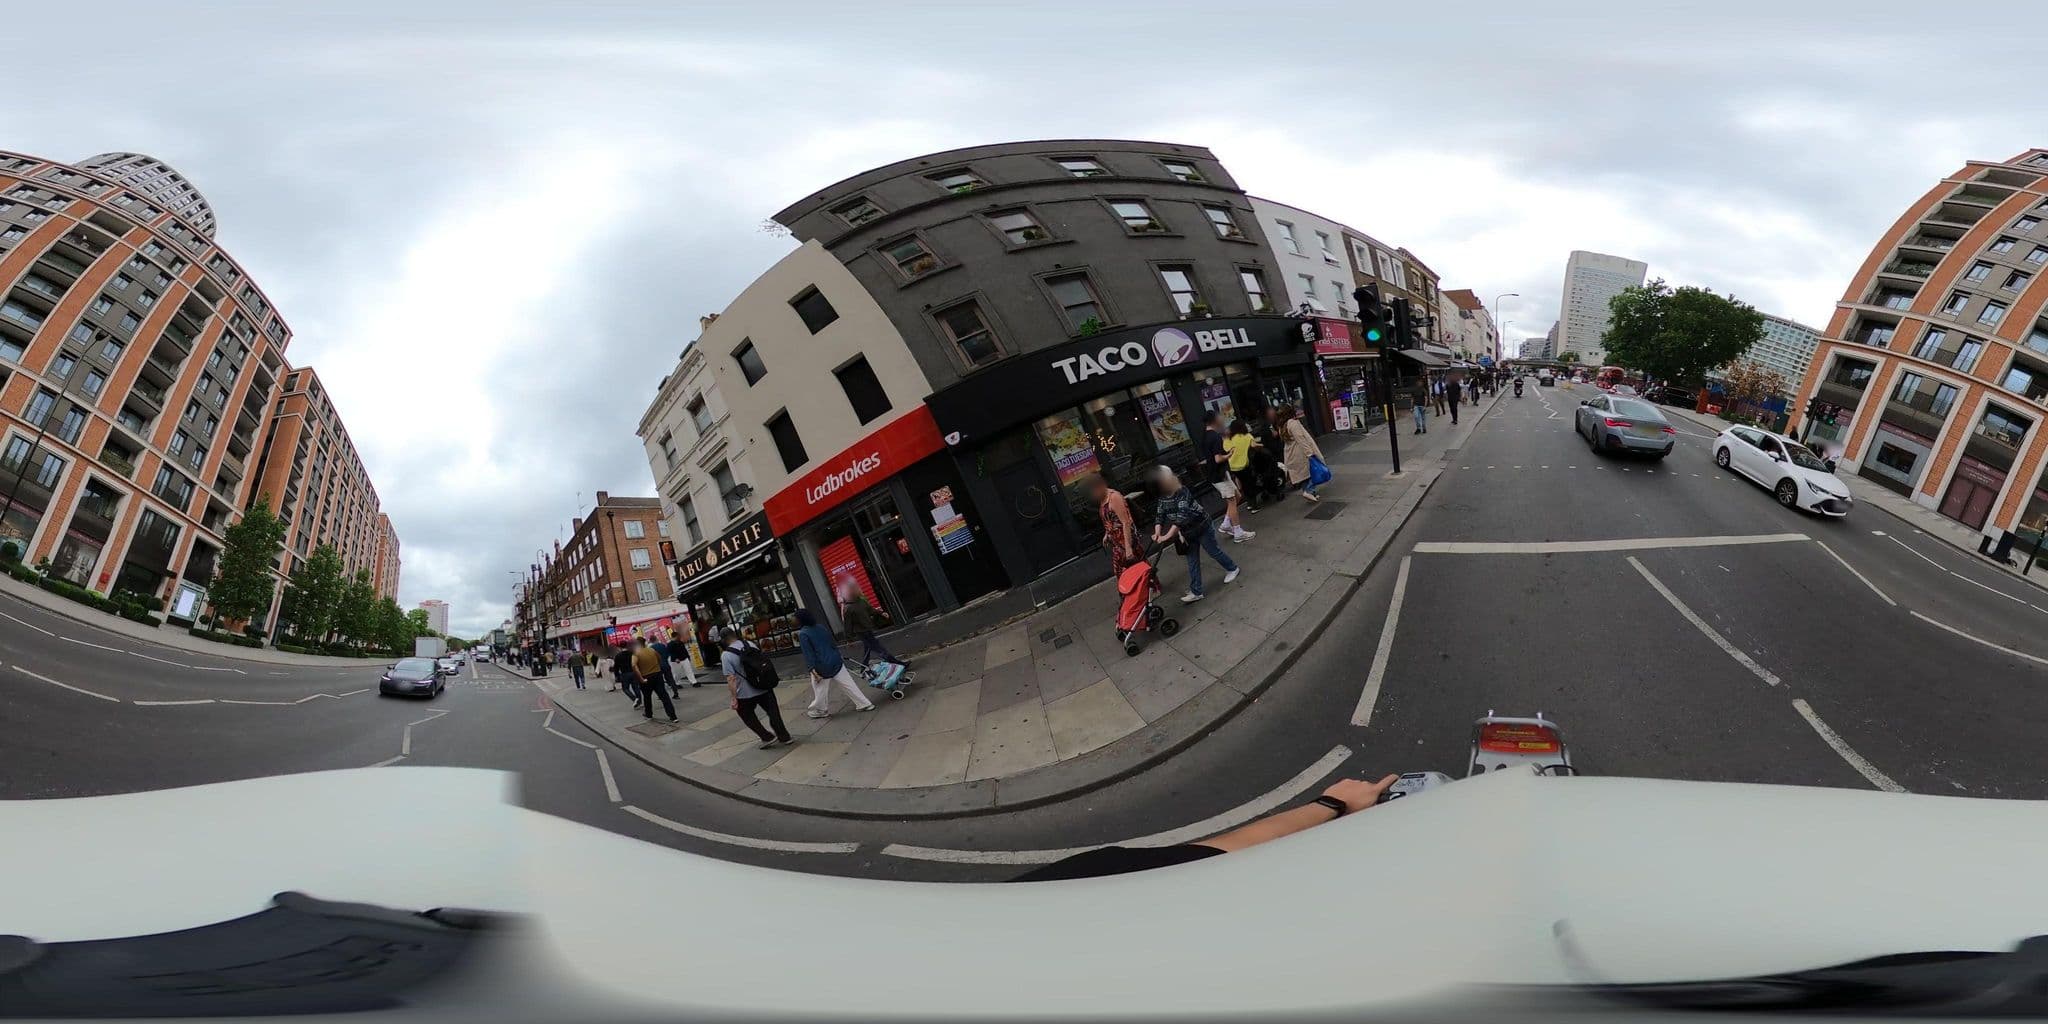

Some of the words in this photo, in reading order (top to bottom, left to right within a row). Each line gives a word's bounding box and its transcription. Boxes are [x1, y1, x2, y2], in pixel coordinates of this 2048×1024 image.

[1052, 342, 1147, 384] TACO
[1195, 328, 1256, 352] BELL
[806, 452, 880, 504] Ladbrokes
[1056, 457, 1072, 470] TACO
[1070, 449, 1094, 465] TUESDAY
[679, 558, 703, 581] ABU
[720, 522, 761, 559] AFIF
